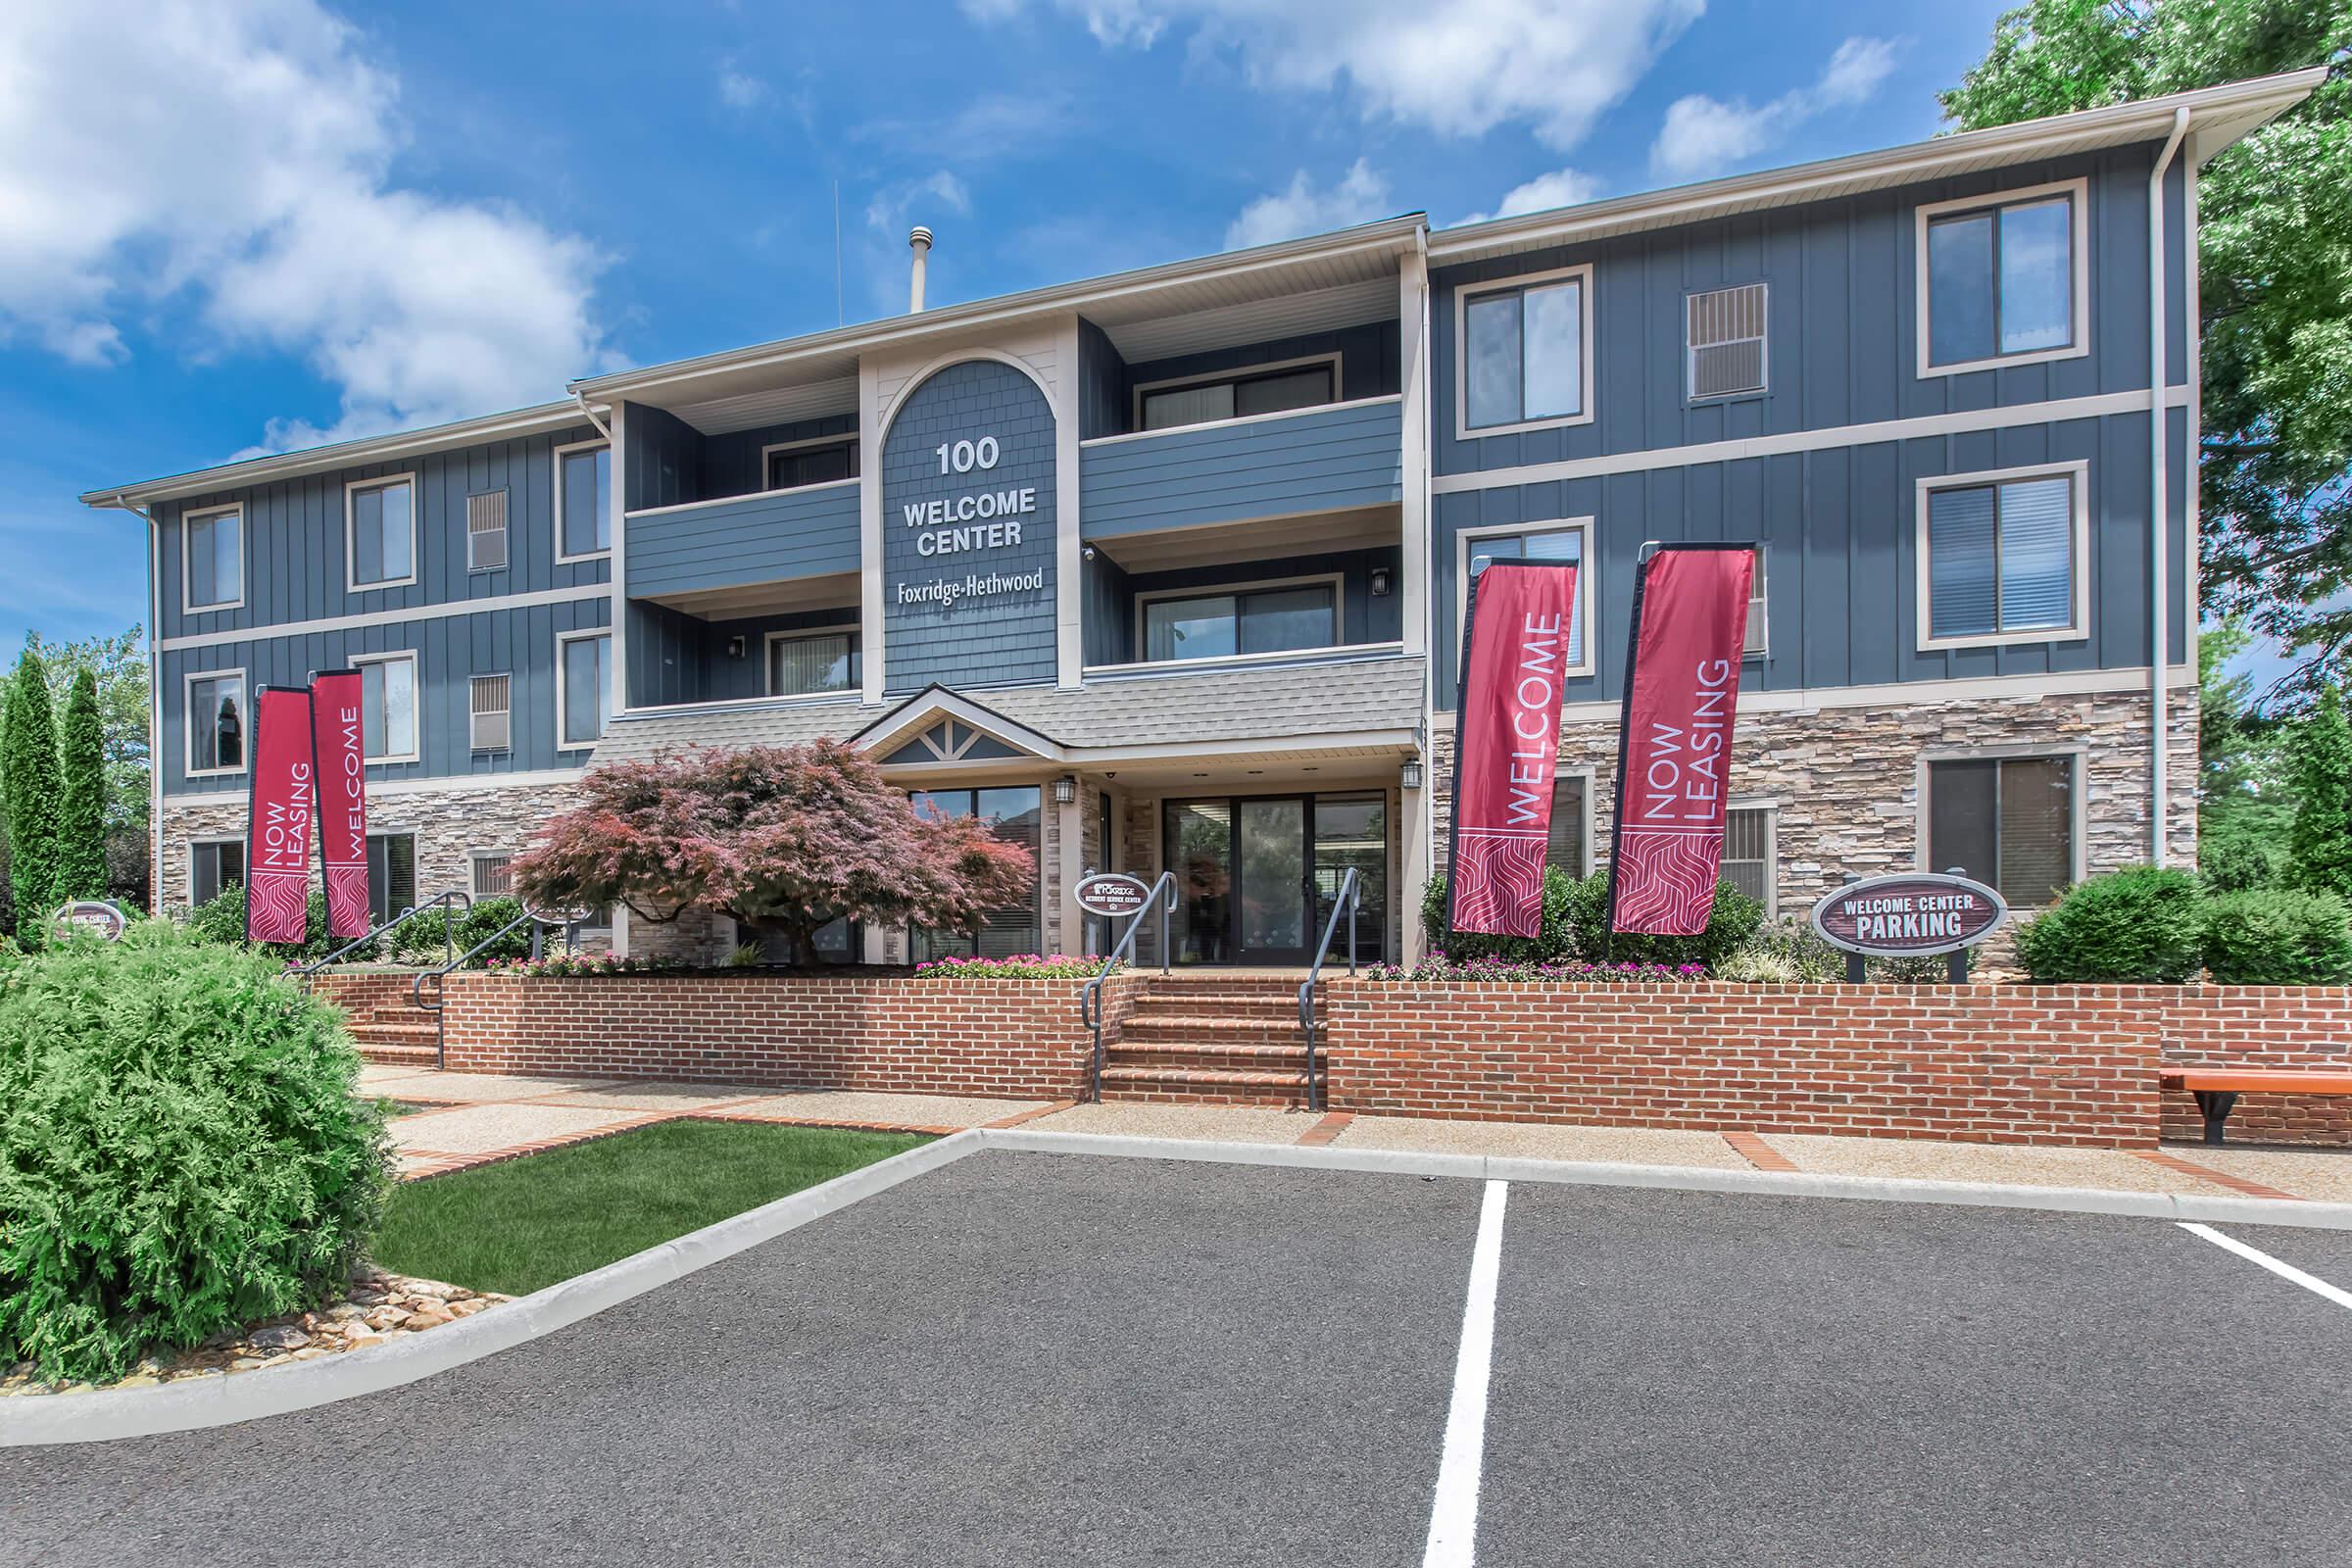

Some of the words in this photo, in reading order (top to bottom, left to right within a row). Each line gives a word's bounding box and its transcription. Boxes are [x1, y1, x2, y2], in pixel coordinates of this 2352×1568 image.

[936, 436, 1000, 474] 100
[904, 487, 1036, 527] WELCOME
[916, 521, 1021, 557] CENTER
[1506, 612, 1560, 824] WELCOME
[1684, 659, 1730, 820] LEASING
[341, 707, 363, 859] WELCOME
[1644, 722, 1684, 819] NOW
[264, 802, 286, 866] NOW
[286, 762, 310, 867] LEASING
[1844, 898, 1911, 915] WELCOME
[1918, 894, 1974, 910] CENTER
[1856, 910, 1962, 940] PARKING
